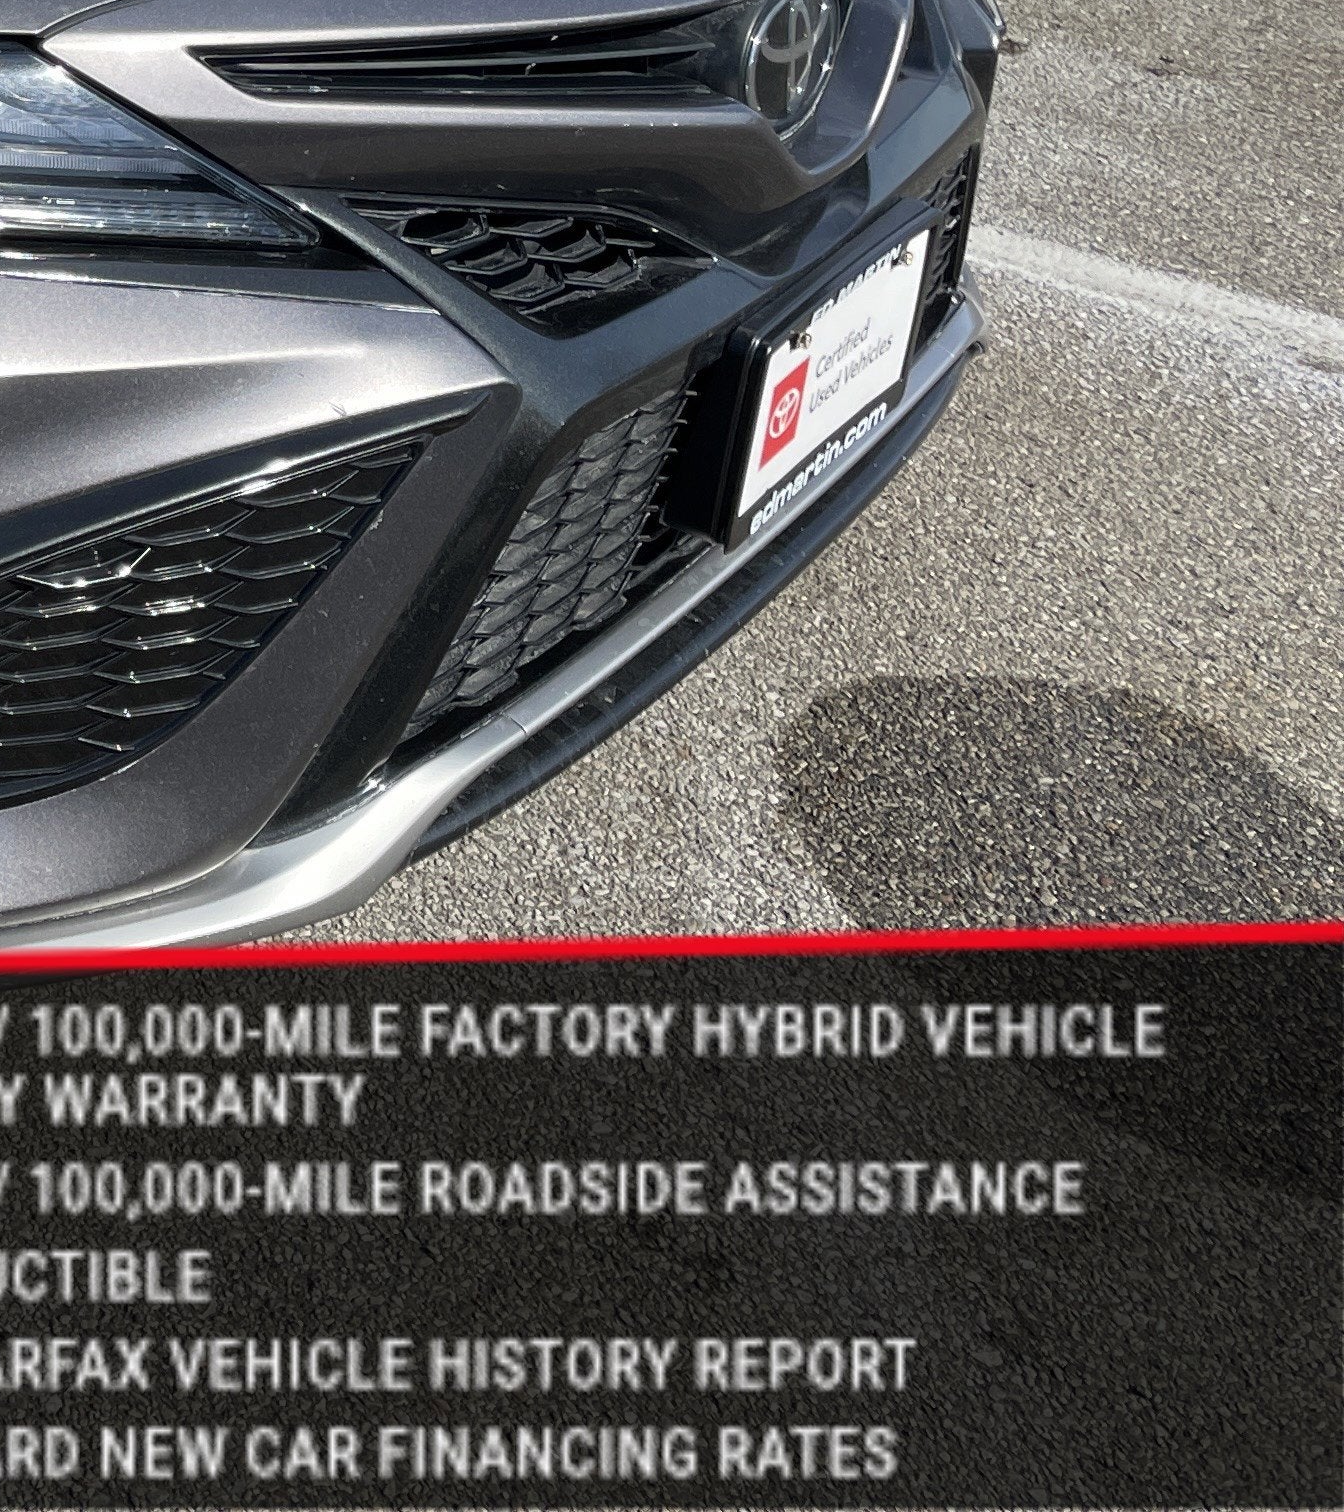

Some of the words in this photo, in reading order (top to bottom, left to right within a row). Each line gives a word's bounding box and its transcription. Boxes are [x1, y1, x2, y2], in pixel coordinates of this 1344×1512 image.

[809, 369, 843, 413] Used
[843, 334, 893, 384] Vehicles
[816, 316, 871, 378] Certified
[750, 402, 887, 535] edmartin.com
